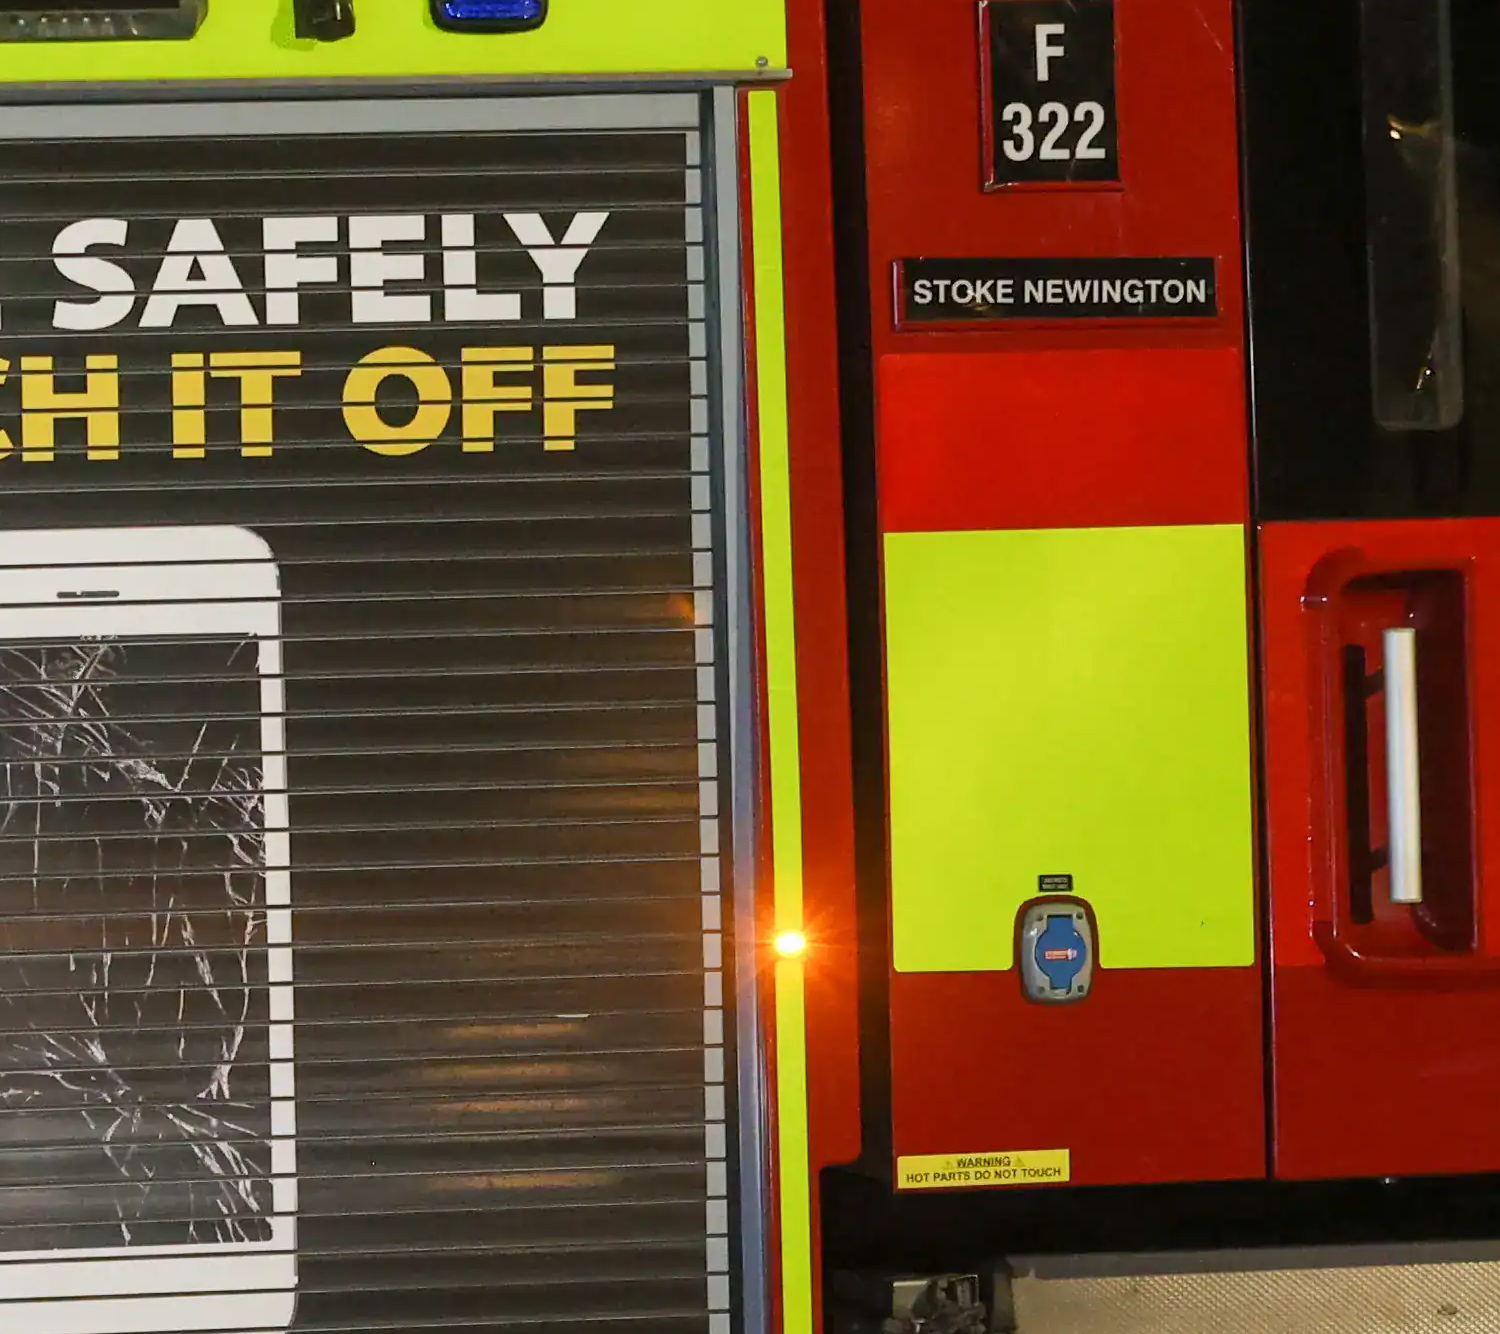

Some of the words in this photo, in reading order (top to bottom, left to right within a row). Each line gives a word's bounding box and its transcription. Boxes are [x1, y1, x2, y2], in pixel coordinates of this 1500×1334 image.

[1034, 23, 1066, 82] F
[1002, 101, 1106, 163] 322
[51, 211, 610, 332] SAFELY
[913, 278, 1014, 304] STOKE
[1023, 278, 1206, 304] NEWINGTON
[171, 350, 302, 461] IT
[341, 344, 616, 457] OFF
[906, 1173, 930, 1183] HOT
[933, 1171, 971, 1182] PARTS
[975, 1170, 991, 1180] DO
[994, 1169, 1017, 1179] NOT
[1022, 1167, 1061, 1178] TOUCH
[956, 1156, 1011, 1168] WARNING
